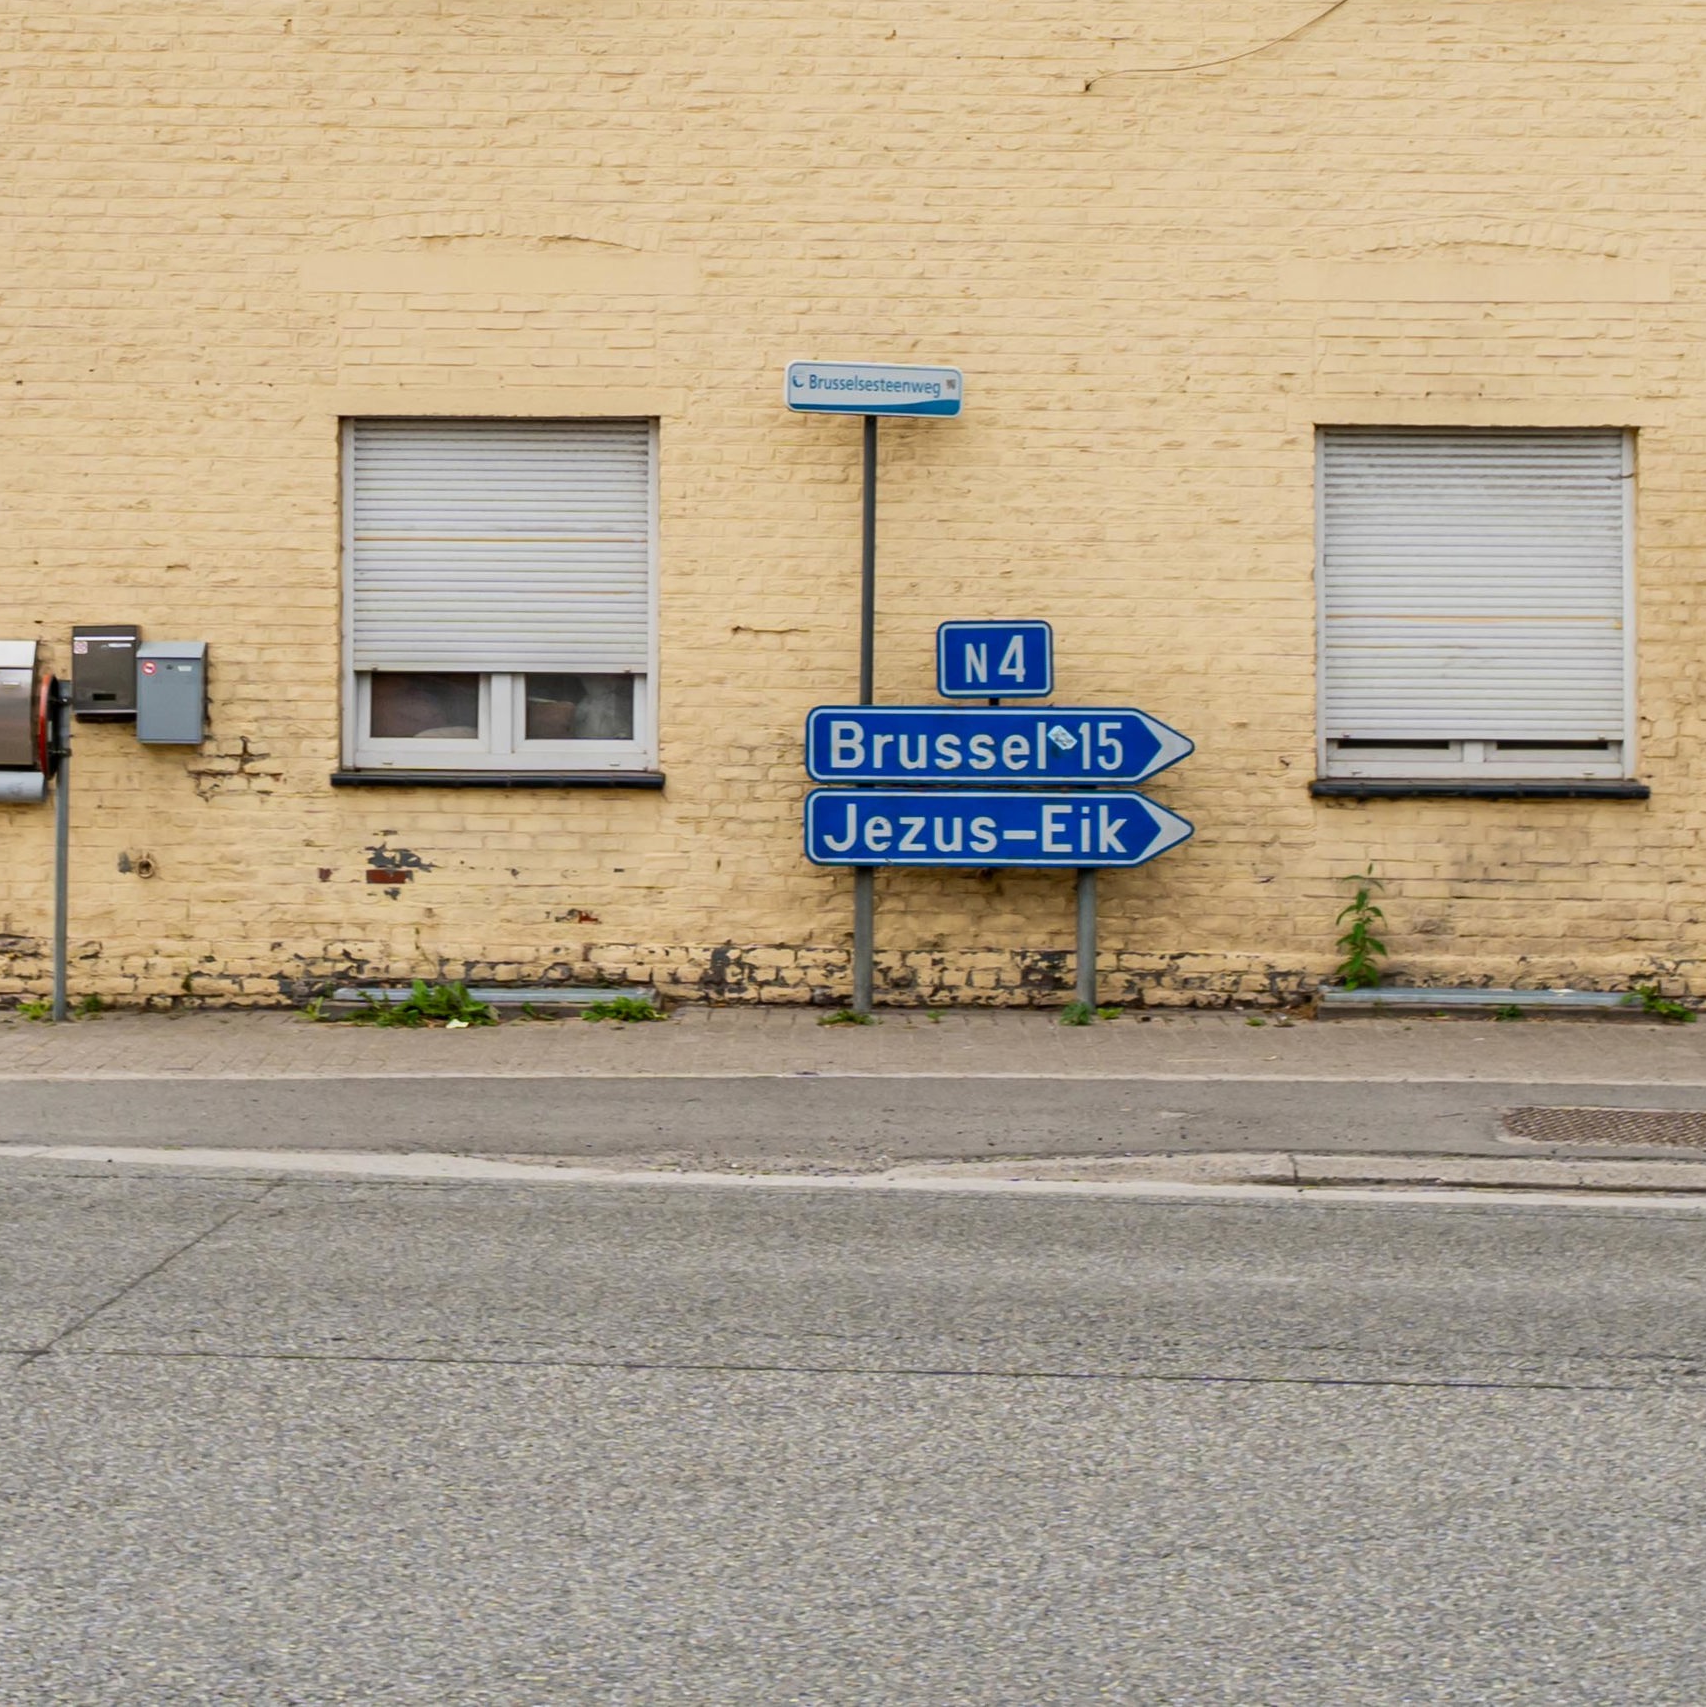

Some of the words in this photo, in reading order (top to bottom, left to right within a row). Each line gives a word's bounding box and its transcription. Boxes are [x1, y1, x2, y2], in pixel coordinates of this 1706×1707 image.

[808, 373, 942, 399] Brusselsesteenweg
[829, 720, 1047, 770] Brussel
[1078, 721, 1124, 771] 15
[822, 803, 1129, 853] Jezus-Eik
